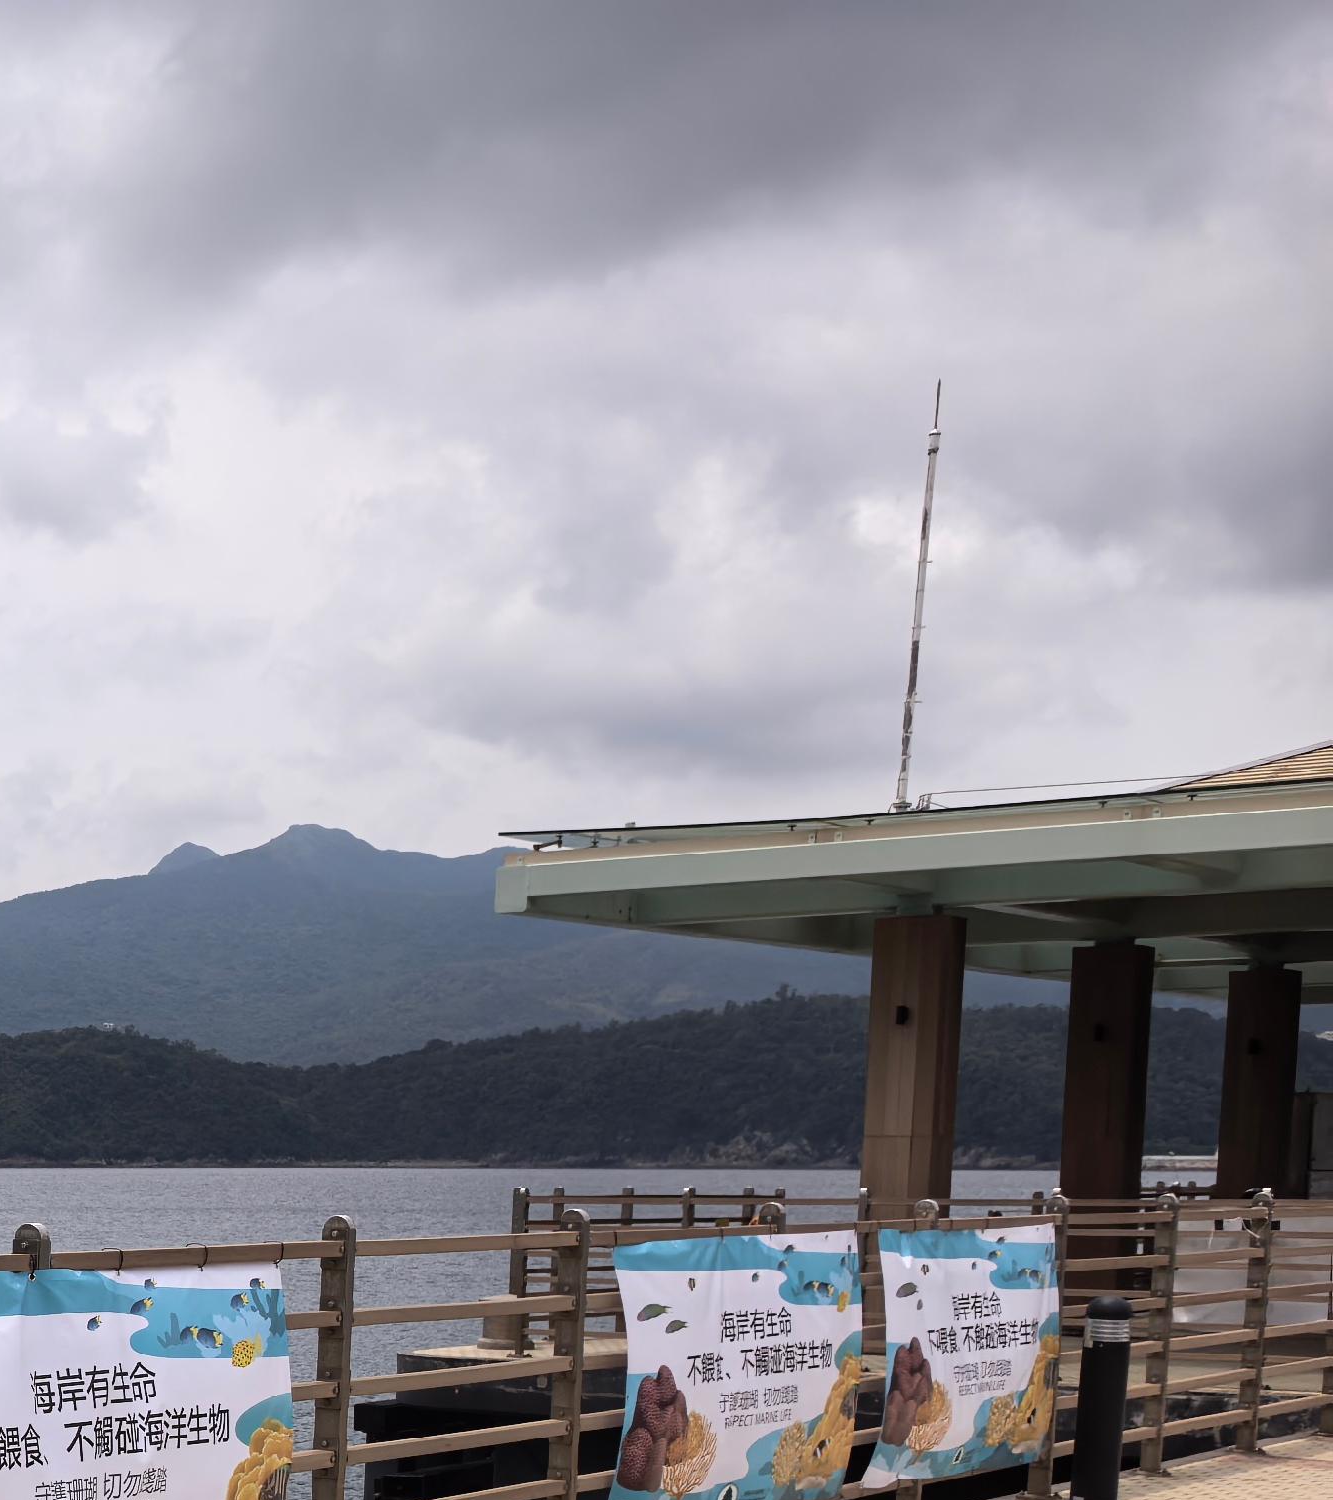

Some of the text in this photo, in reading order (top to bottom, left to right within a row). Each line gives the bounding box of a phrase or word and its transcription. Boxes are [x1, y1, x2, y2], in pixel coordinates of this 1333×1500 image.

[720, 1306, 792, 1343] 海岸有生命
[30, 1361, 157, 1415] 海岸有生命
[724, 1414, 753, 1429] RPECT
